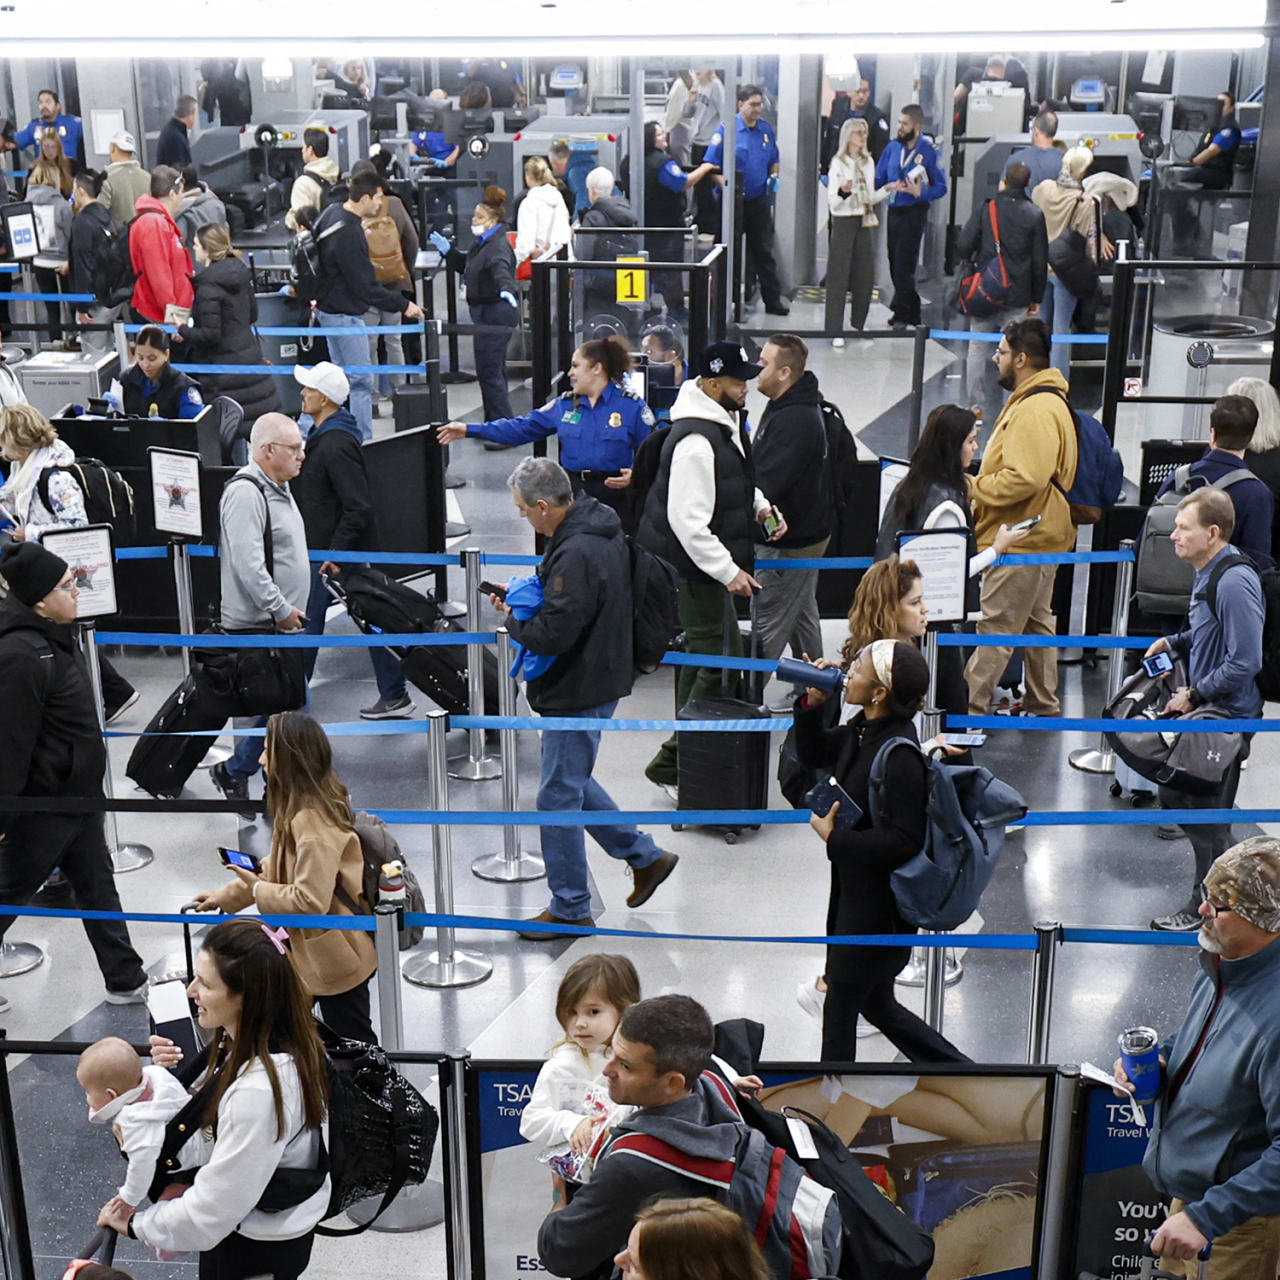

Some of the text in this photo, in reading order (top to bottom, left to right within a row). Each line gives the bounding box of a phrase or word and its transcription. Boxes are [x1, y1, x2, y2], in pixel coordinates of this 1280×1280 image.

[624, 271, 639, 298] 1
[493, 1083, 534, 1103] TSA
[497, 1106, 523, 1117] Trav
[1106, 1126, 1143, 1139] Travel
[1114, 1227, 1139, 1242] so
